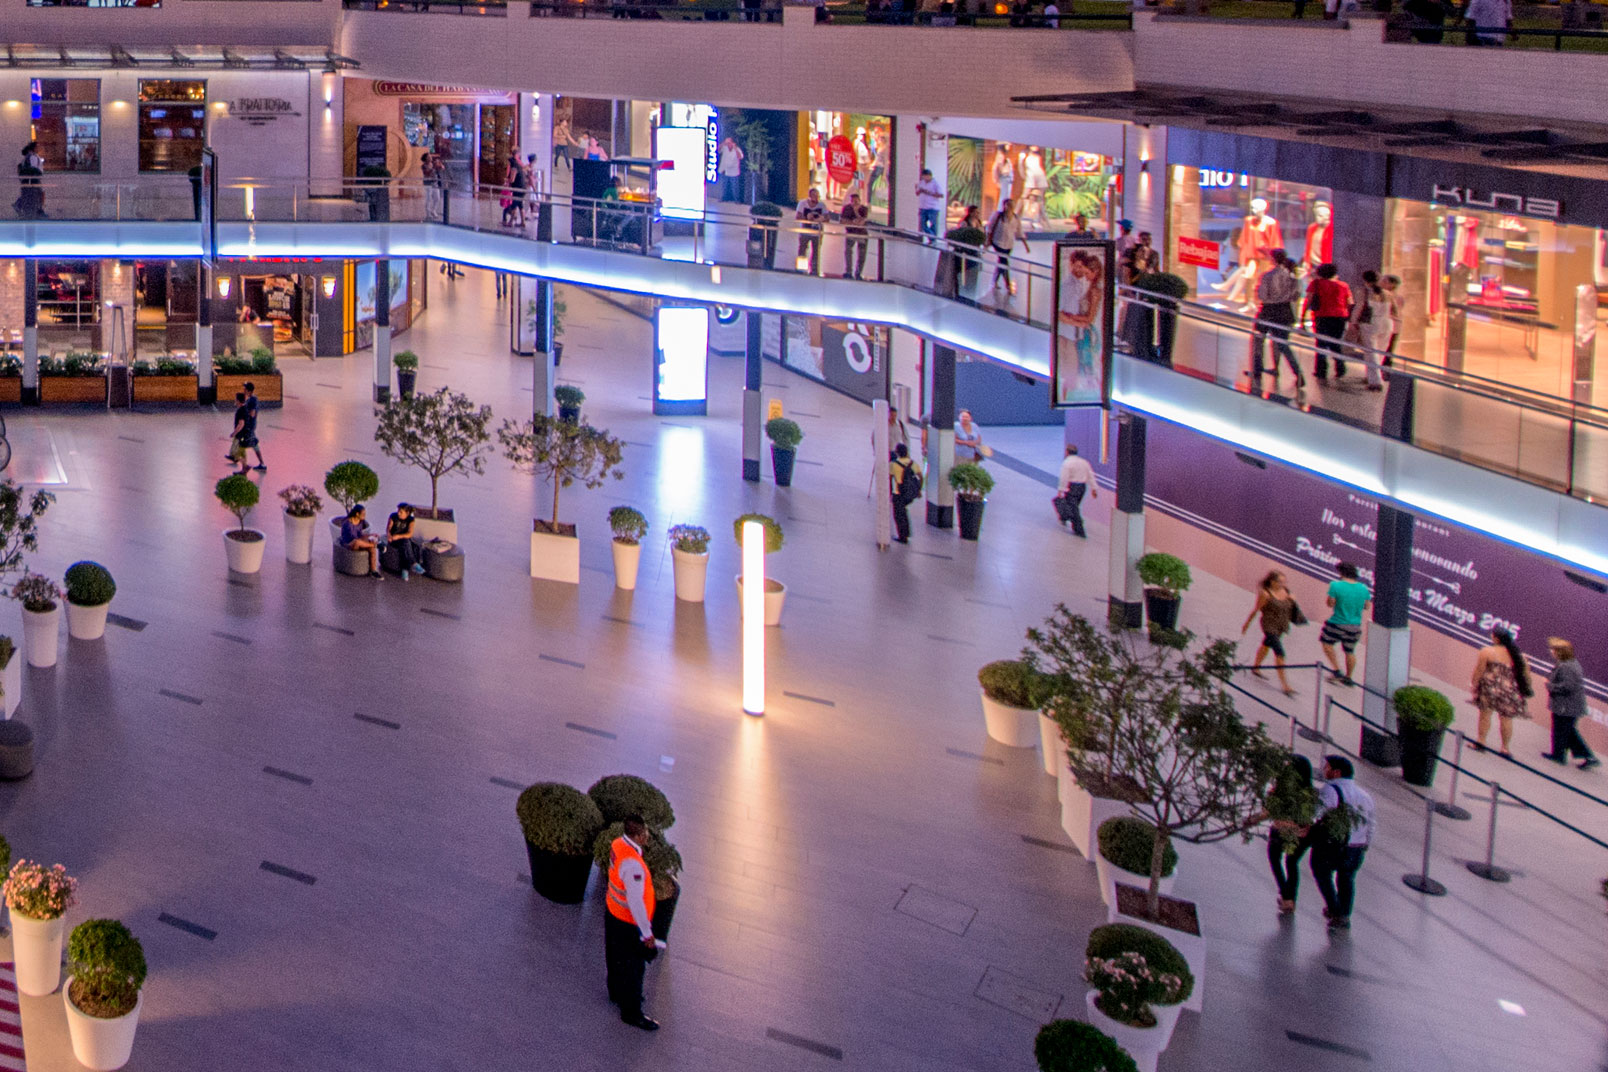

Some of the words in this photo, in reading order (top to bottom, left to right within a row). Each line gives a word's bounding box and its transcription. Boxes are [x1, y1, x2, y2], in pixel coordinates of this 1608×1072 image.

[707, 122, 718, 183] Studio
[832, 151, 852, 168] 50%
[1179, 241, 1218, 262] Rebajas
[1321, 507, 1345, 529] Nos
[1351, 521, 1378, 541] esta
[1425, 588, 1476, 625] Marzo
